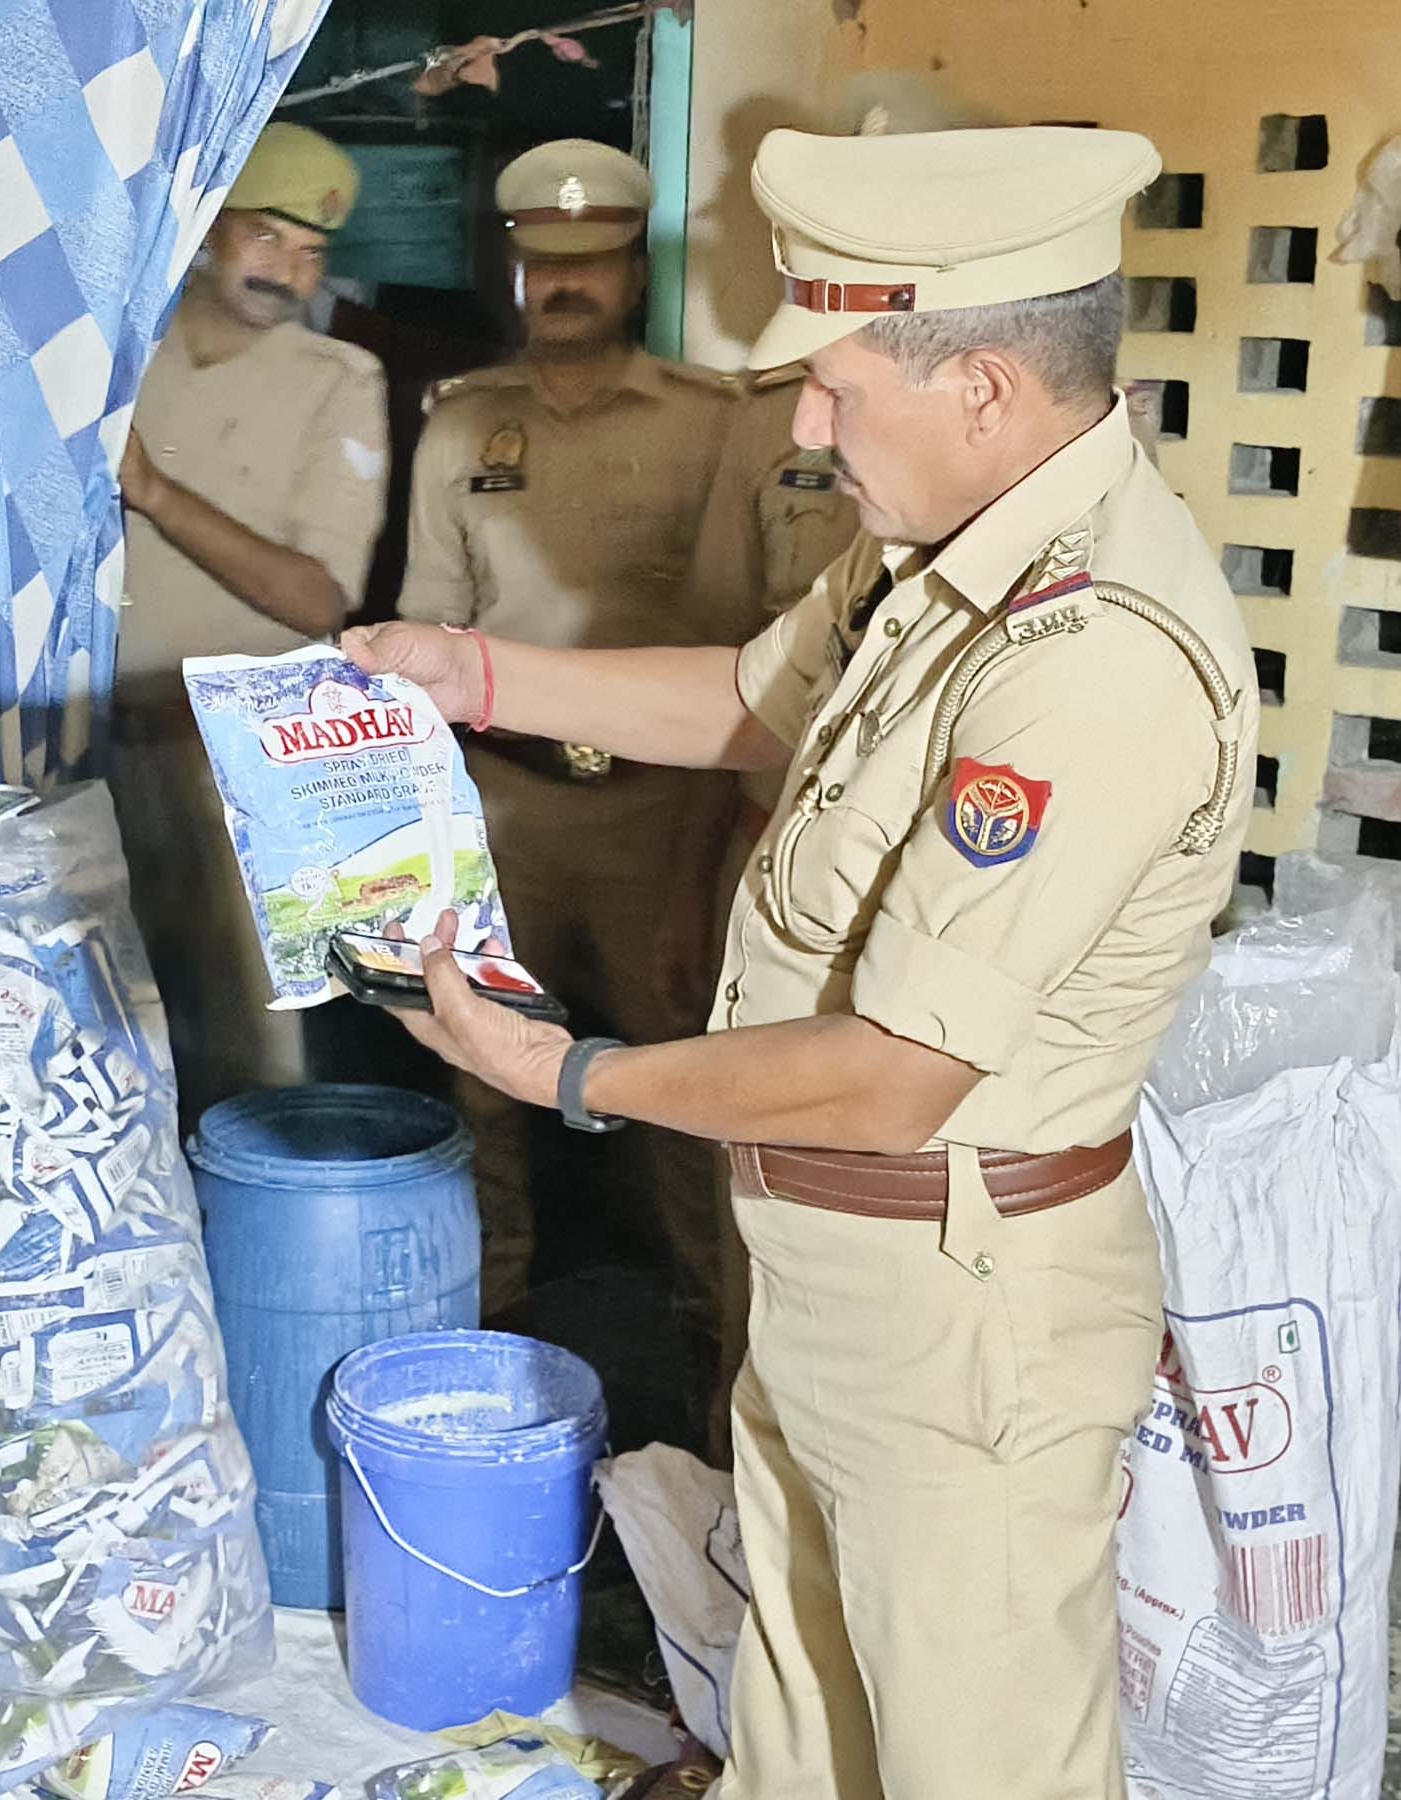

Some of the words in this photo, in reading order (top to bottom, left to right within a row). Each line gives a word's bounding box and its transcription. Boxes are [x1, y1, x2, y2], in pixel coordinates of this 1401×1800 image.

[271, 703, 415, 756] MADHAV
[369, 748, 408, 766] DRIED
[290, 774, 358, 800] SKIMMED
[360, 769, 390, 785] MILK
[319, 786, 390, 810] STANDARD
[1218, 1503, 1307, 1531] WDER
[1134, 1584, 1186, 1621] (Approx.)
